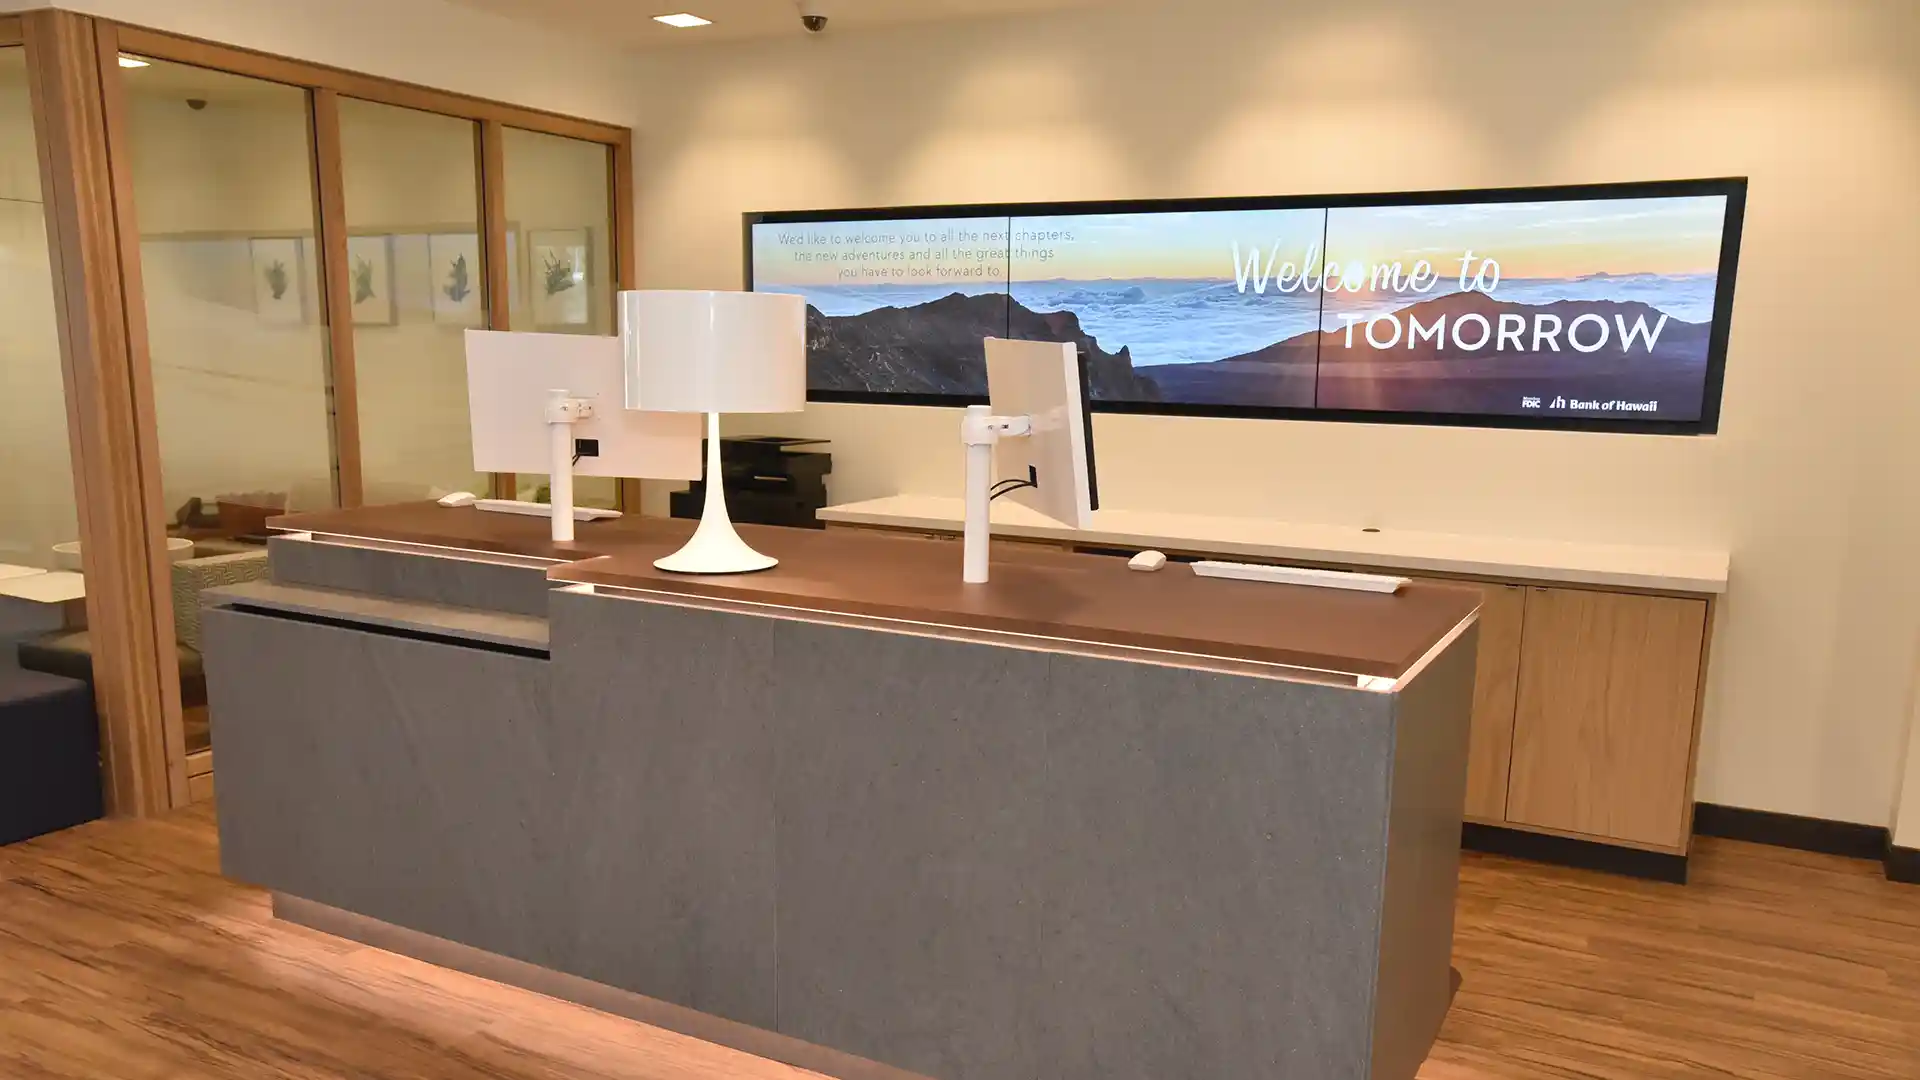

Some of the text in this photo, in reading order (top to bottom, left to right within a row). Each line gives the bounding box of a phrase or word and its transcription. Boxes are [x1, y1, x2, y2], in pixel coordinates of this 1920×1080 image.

[807, 231, 827, 244] like
[830, 234, 841, 244] to
[844, 231, 896, 244] welcome
[900, 232, 920, 245] you
[924, 232, 937, 243] to
[941, 227, 954, 242] all
[958, 229, 979, 241] the
[983, 229, 1009, 242] next
[1015, 228, 1075, 244] chapters,
[794, 244, 1054, 262] the new adventures and all the great things
[838, 267, 857, 281] you
[861, 264, 888, 277] have
[891, 266, 904, 277] to
[907, 263, 932, 277] look
[936, 264, 983, 277] forward
[1231, 238, 1500, 294] Welcome to
[1337, 312, 1669, 354] TOMORROW
[1522, 400, 1541, 409] FDIC
[1570, 399, 1658, 412] Bank of Hawaii
